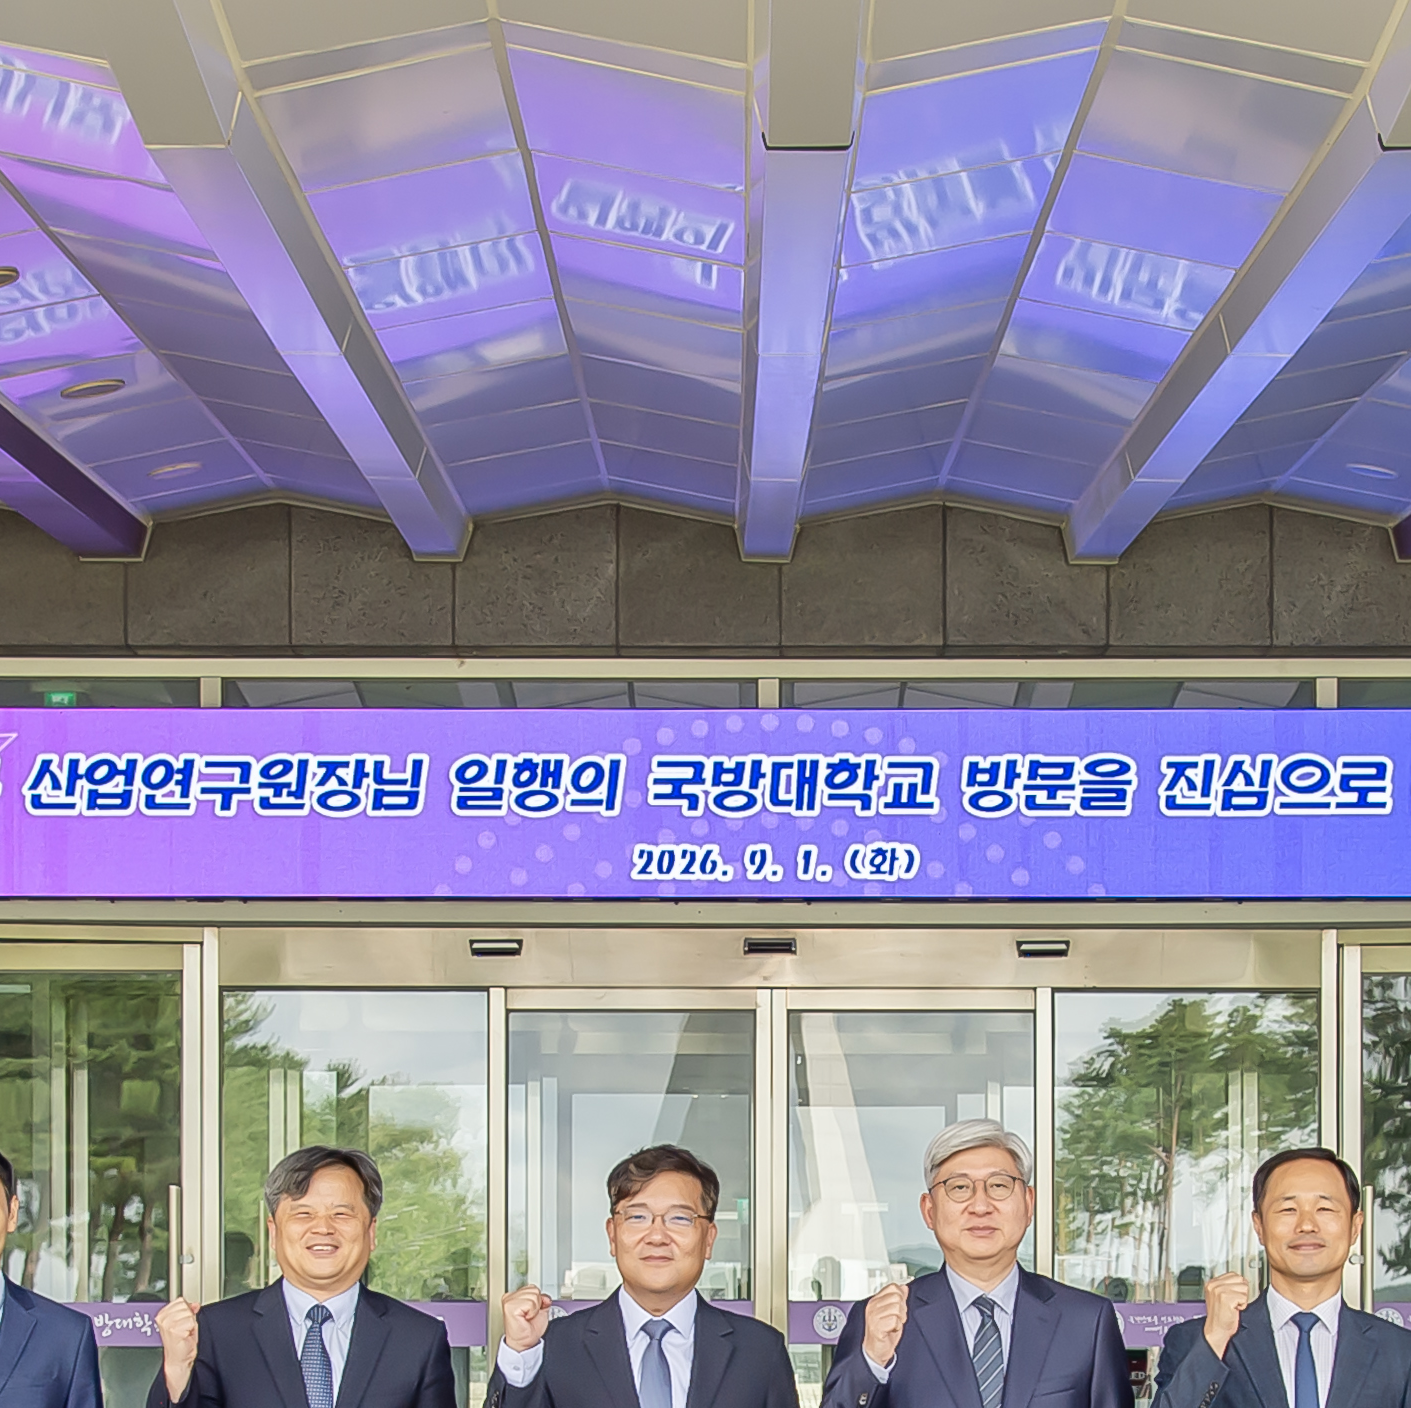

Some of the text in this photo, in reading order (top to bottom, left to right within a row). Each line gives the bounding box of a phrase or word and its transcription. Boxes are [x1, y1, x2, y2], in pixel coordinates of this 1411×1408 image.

[28, 757, 424, 812] 산업연구원장님
[454, 757, 622, 812] 일행의
[652, 758, 935, 812] 국방대학교
[965, 757, 1133, 812] 방문을
[1163, 757, 1387, 812] 진심으로
[637, 846, 917, 878] 2026. 9. 1. (화)
[93, 1311, 160, 1338] 방대학
